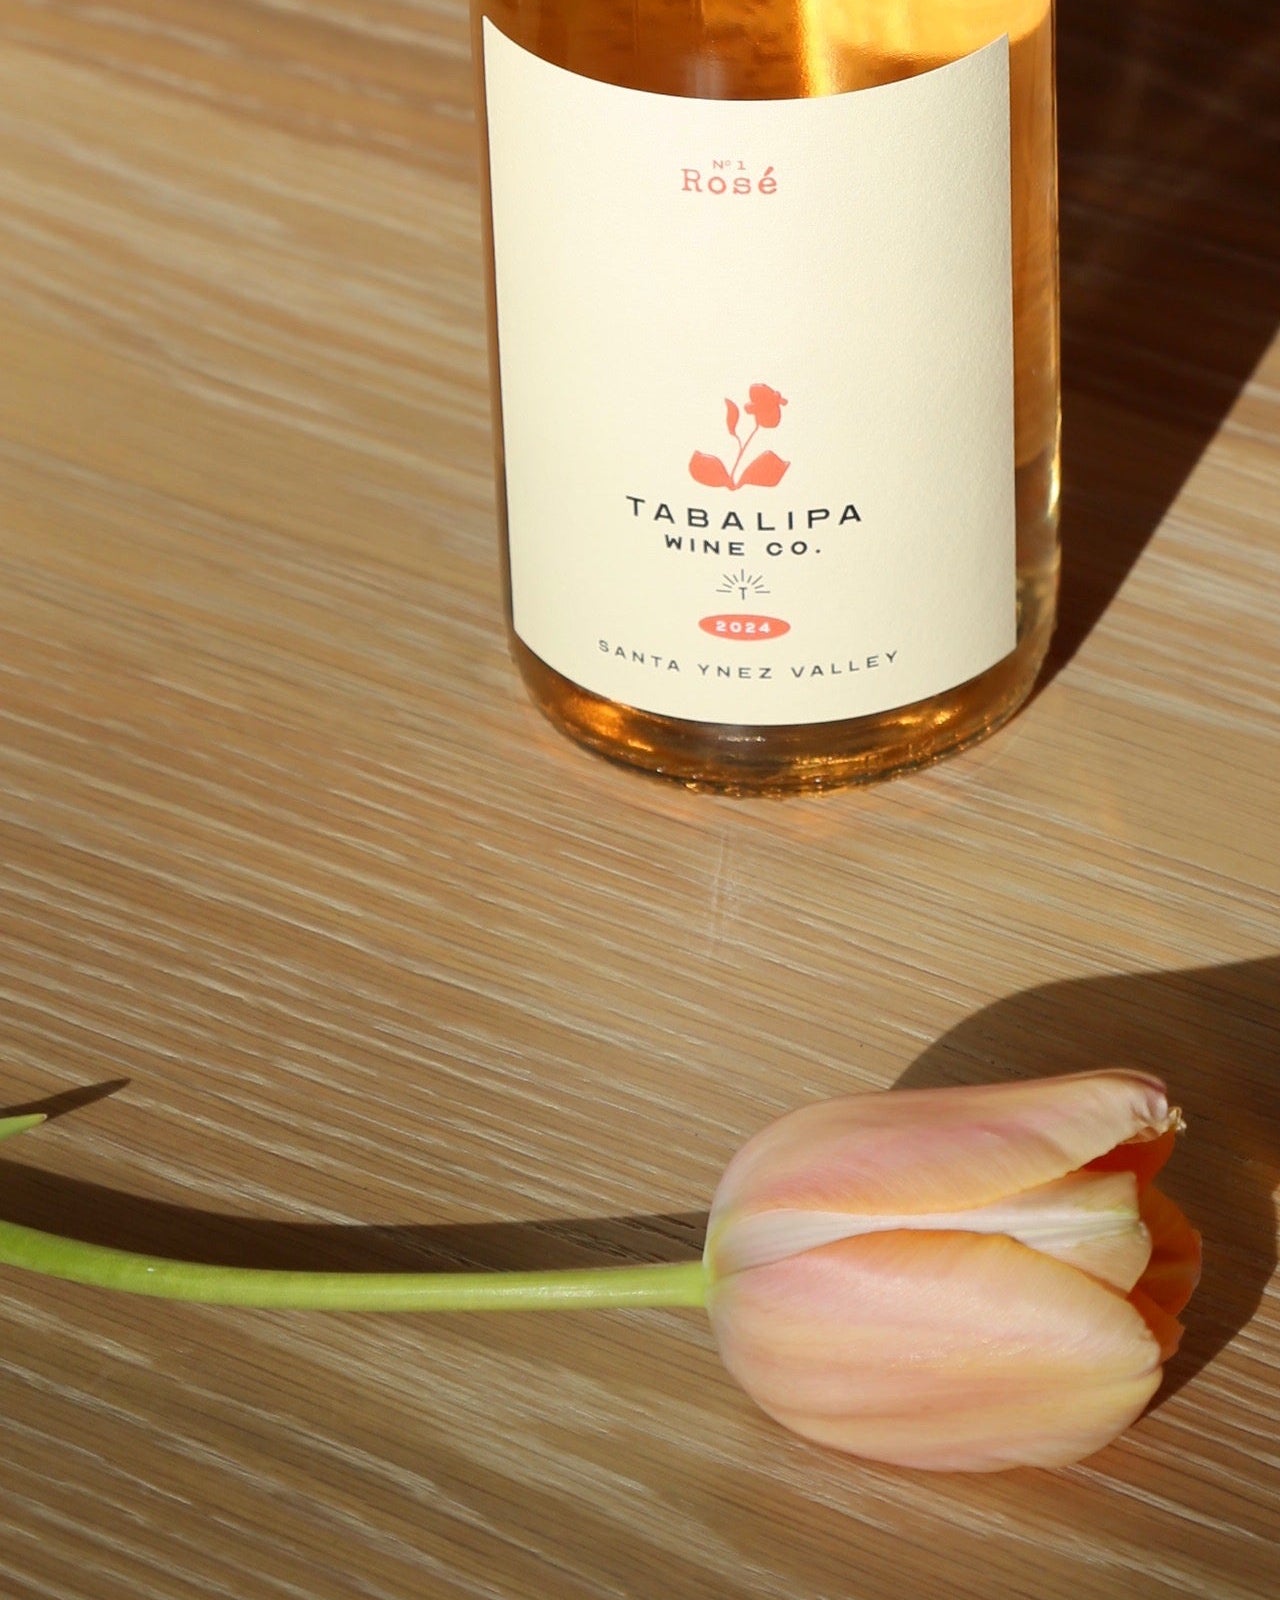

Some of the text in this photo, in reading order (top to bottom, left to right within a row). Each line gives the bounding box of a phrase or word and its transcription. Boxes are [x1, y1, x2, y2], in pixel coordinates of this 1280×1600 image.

[681, 166, 777, 195] Rosé
[626, 495, 862, 531] TABALIPA
[665, 534, 821, 557] WINE CO.
[738, 587, 748, 600] T
[715, 620, 771, 634] 2024
[598, 639, 898, 679] SANTA YNEZ VALLEY
